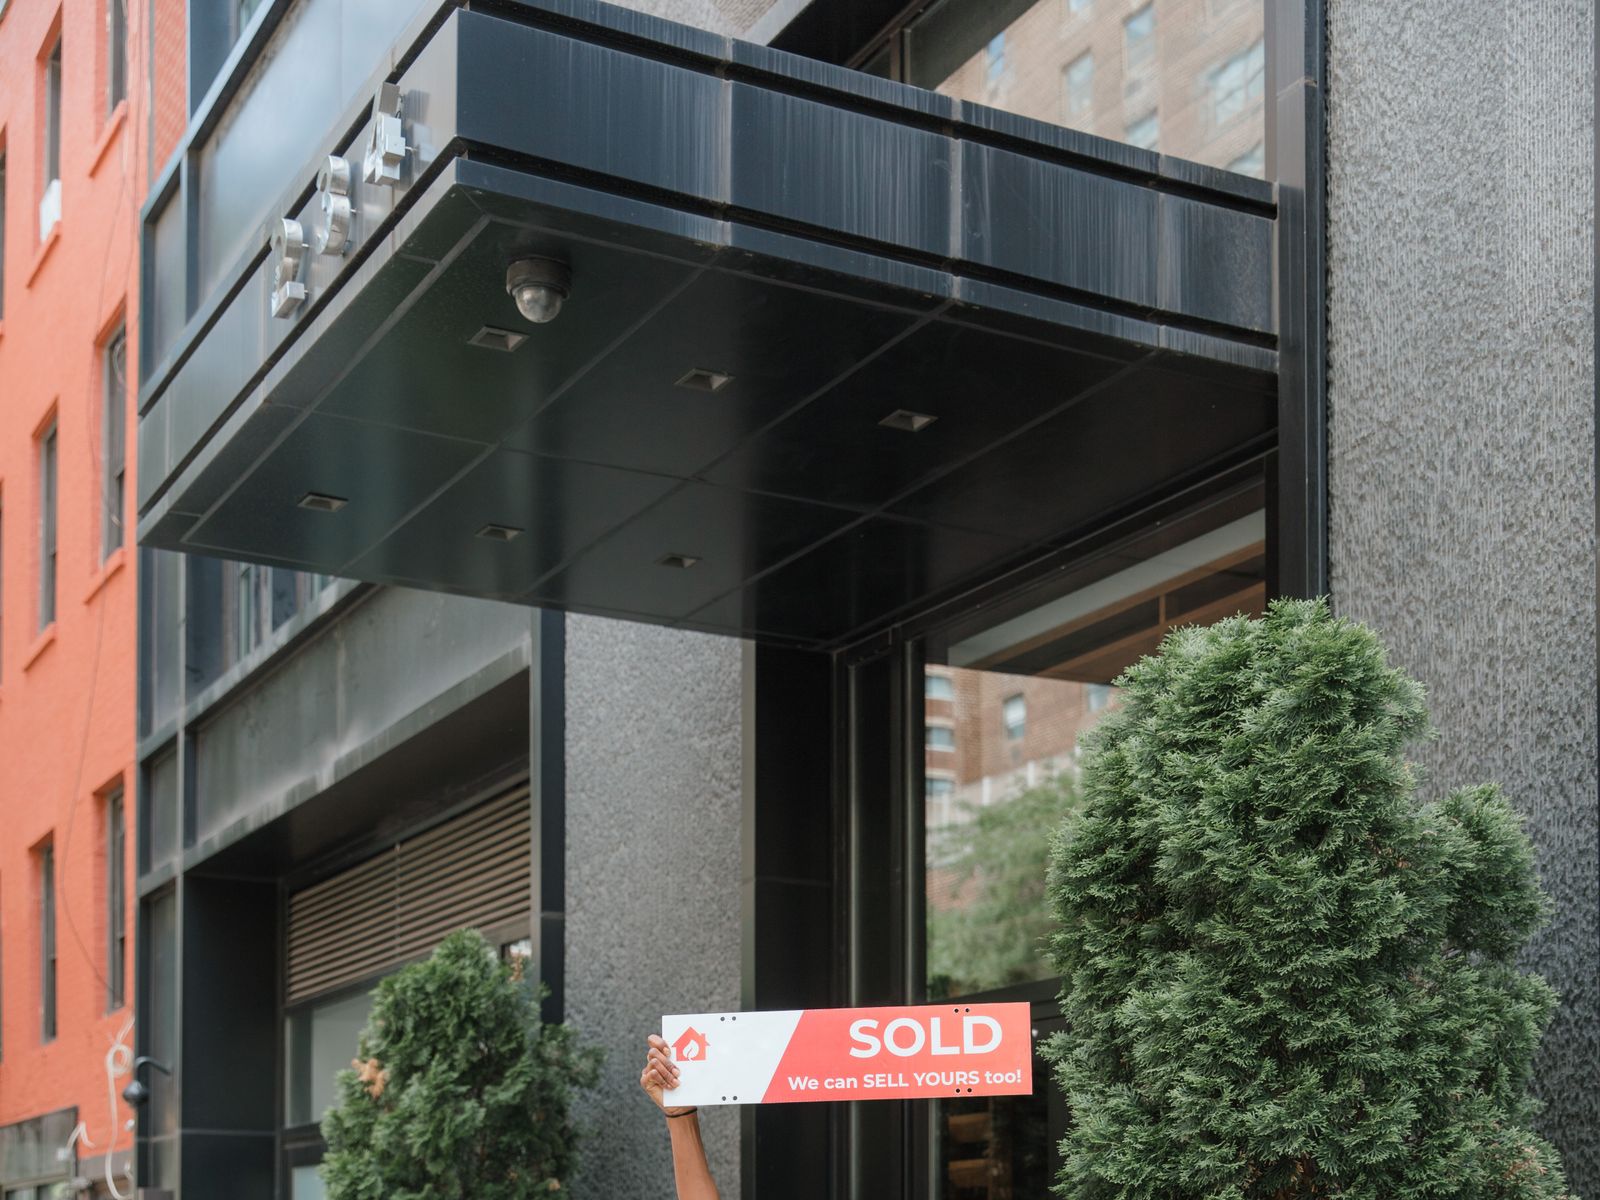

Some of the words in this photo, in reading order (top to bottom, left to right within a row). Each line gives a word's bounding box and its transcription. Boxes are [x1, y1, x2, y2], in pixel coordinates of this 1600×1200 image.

[849, 1015, 1003, 1059] SOLD
[787, 1075, 820, 1091] We
[823, 1076, 859, 1090] can
[863, 1073, 910, 1089] SELL
[913, 1070, 980, 1087] YOURS
[984, 1069, 1022, 1085] too!
